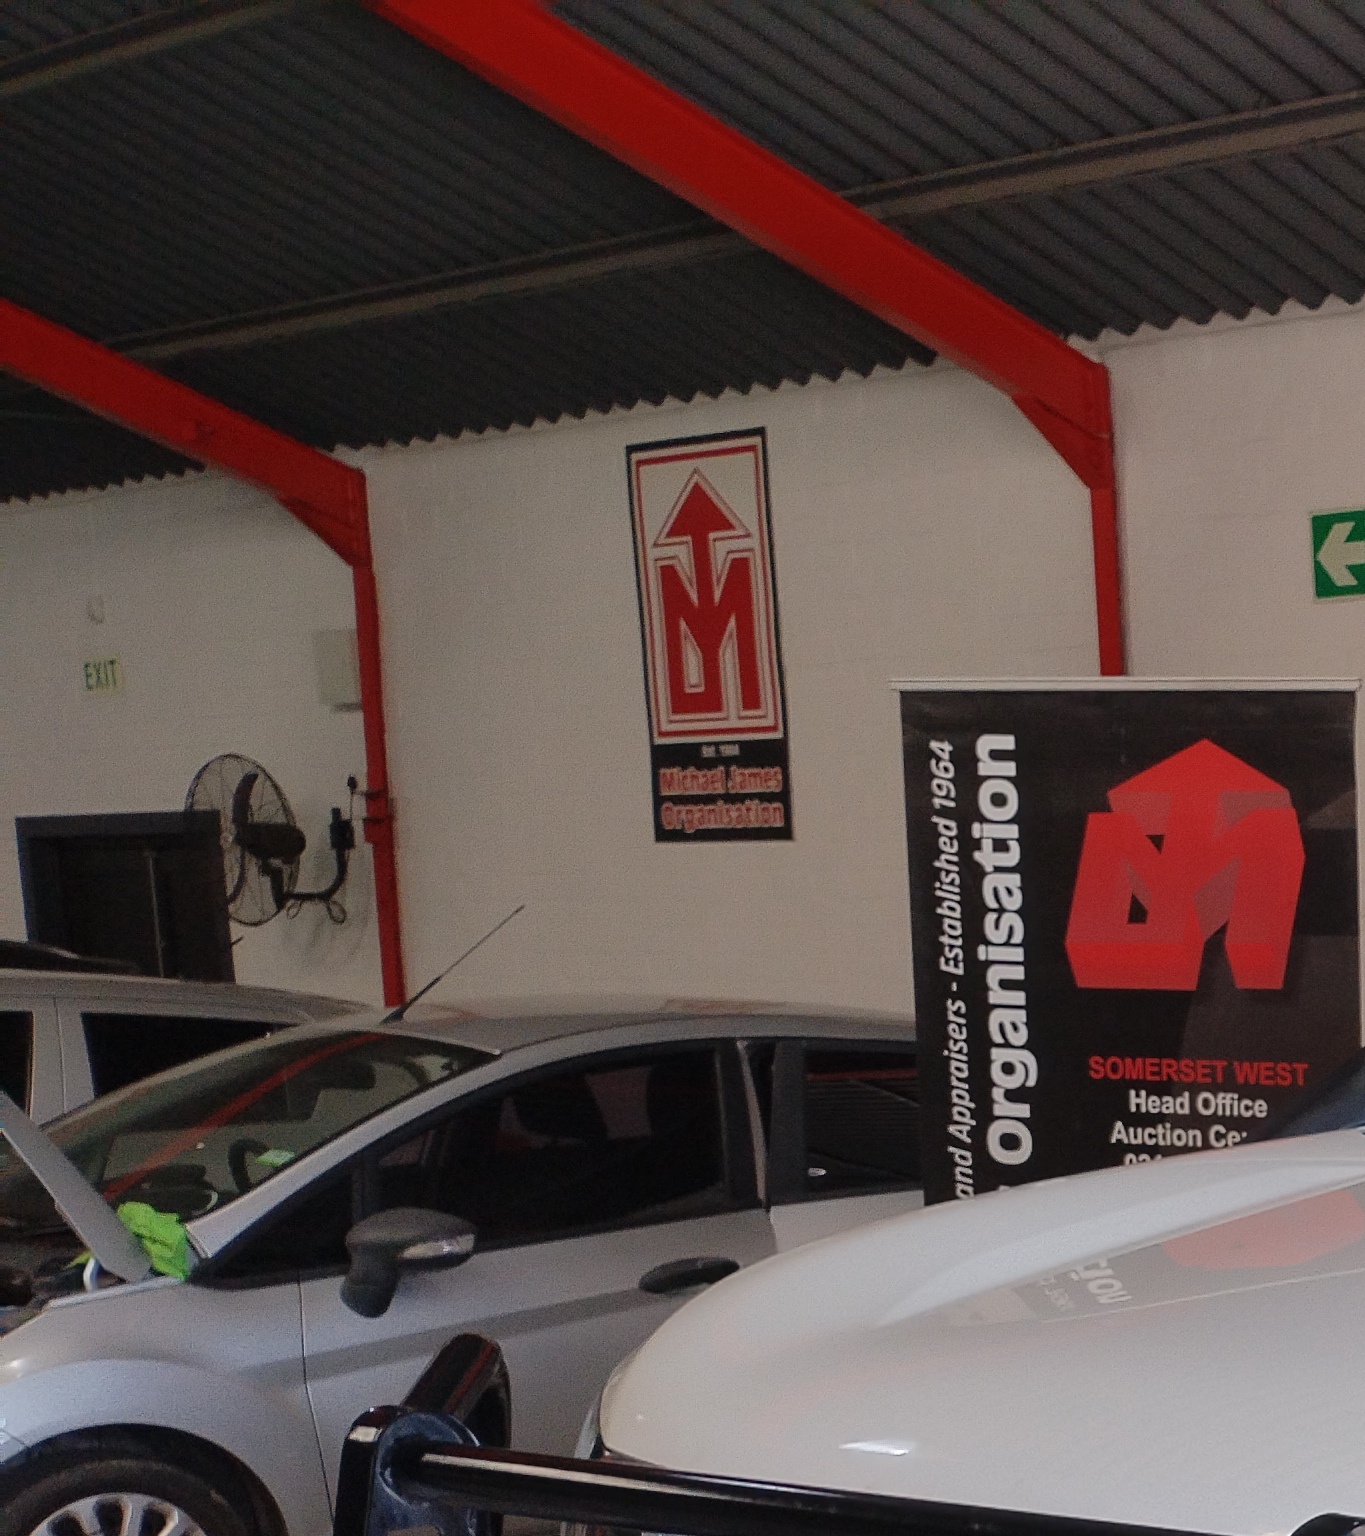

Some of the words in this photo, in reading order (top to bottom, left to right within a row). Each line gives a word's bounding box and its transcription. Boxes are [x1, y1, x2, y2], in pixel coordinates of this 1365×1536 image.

[83, 658, 117, 692] EXIT
[659, 765, 726, 796] Michael
[727, 764, 783, 794] James
[929, 738, 957, 809] 1964
[661, 798, 785, 834] Organisation
[930, 815, 965, 976] Established
[971, 733, 1038, 1166] Organisation
[942, 998, 977, 1144] Appraisers
[1088, 1055, 1228, 1084] SOMERSET
[1232, 1060, 1309, 1087] WEST
[1128, 1089, 1190, 1115] Head
[1196, 1092, 1269, 1118] Office
[1110, 1120, 1203, 1148] Auction
